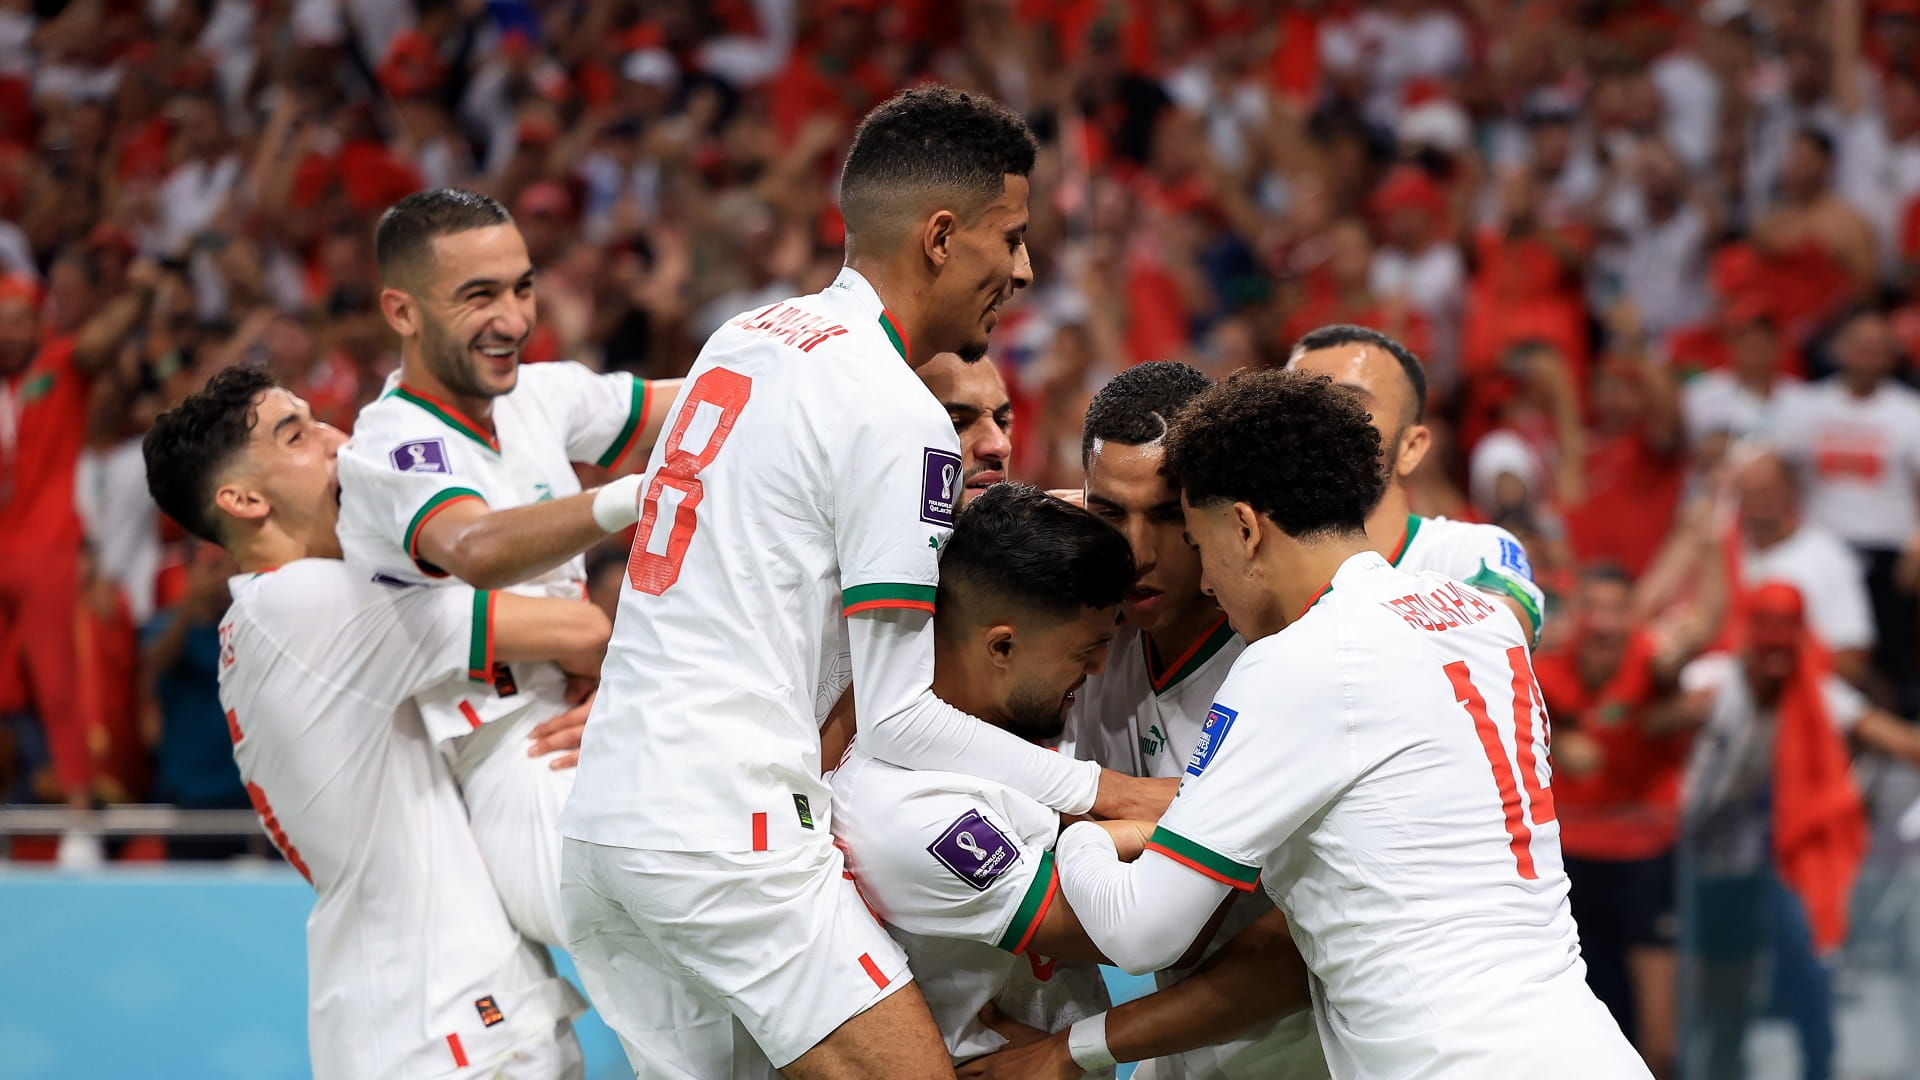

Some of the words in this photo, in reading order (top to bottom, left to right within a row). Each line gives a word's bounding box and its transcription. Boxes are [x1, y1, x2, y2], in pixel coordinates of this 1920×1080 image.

[628, 366, 752, 597] 8
[979, 853, 997, 870] WORLD
[1443, 646, 1557, 880] 14
